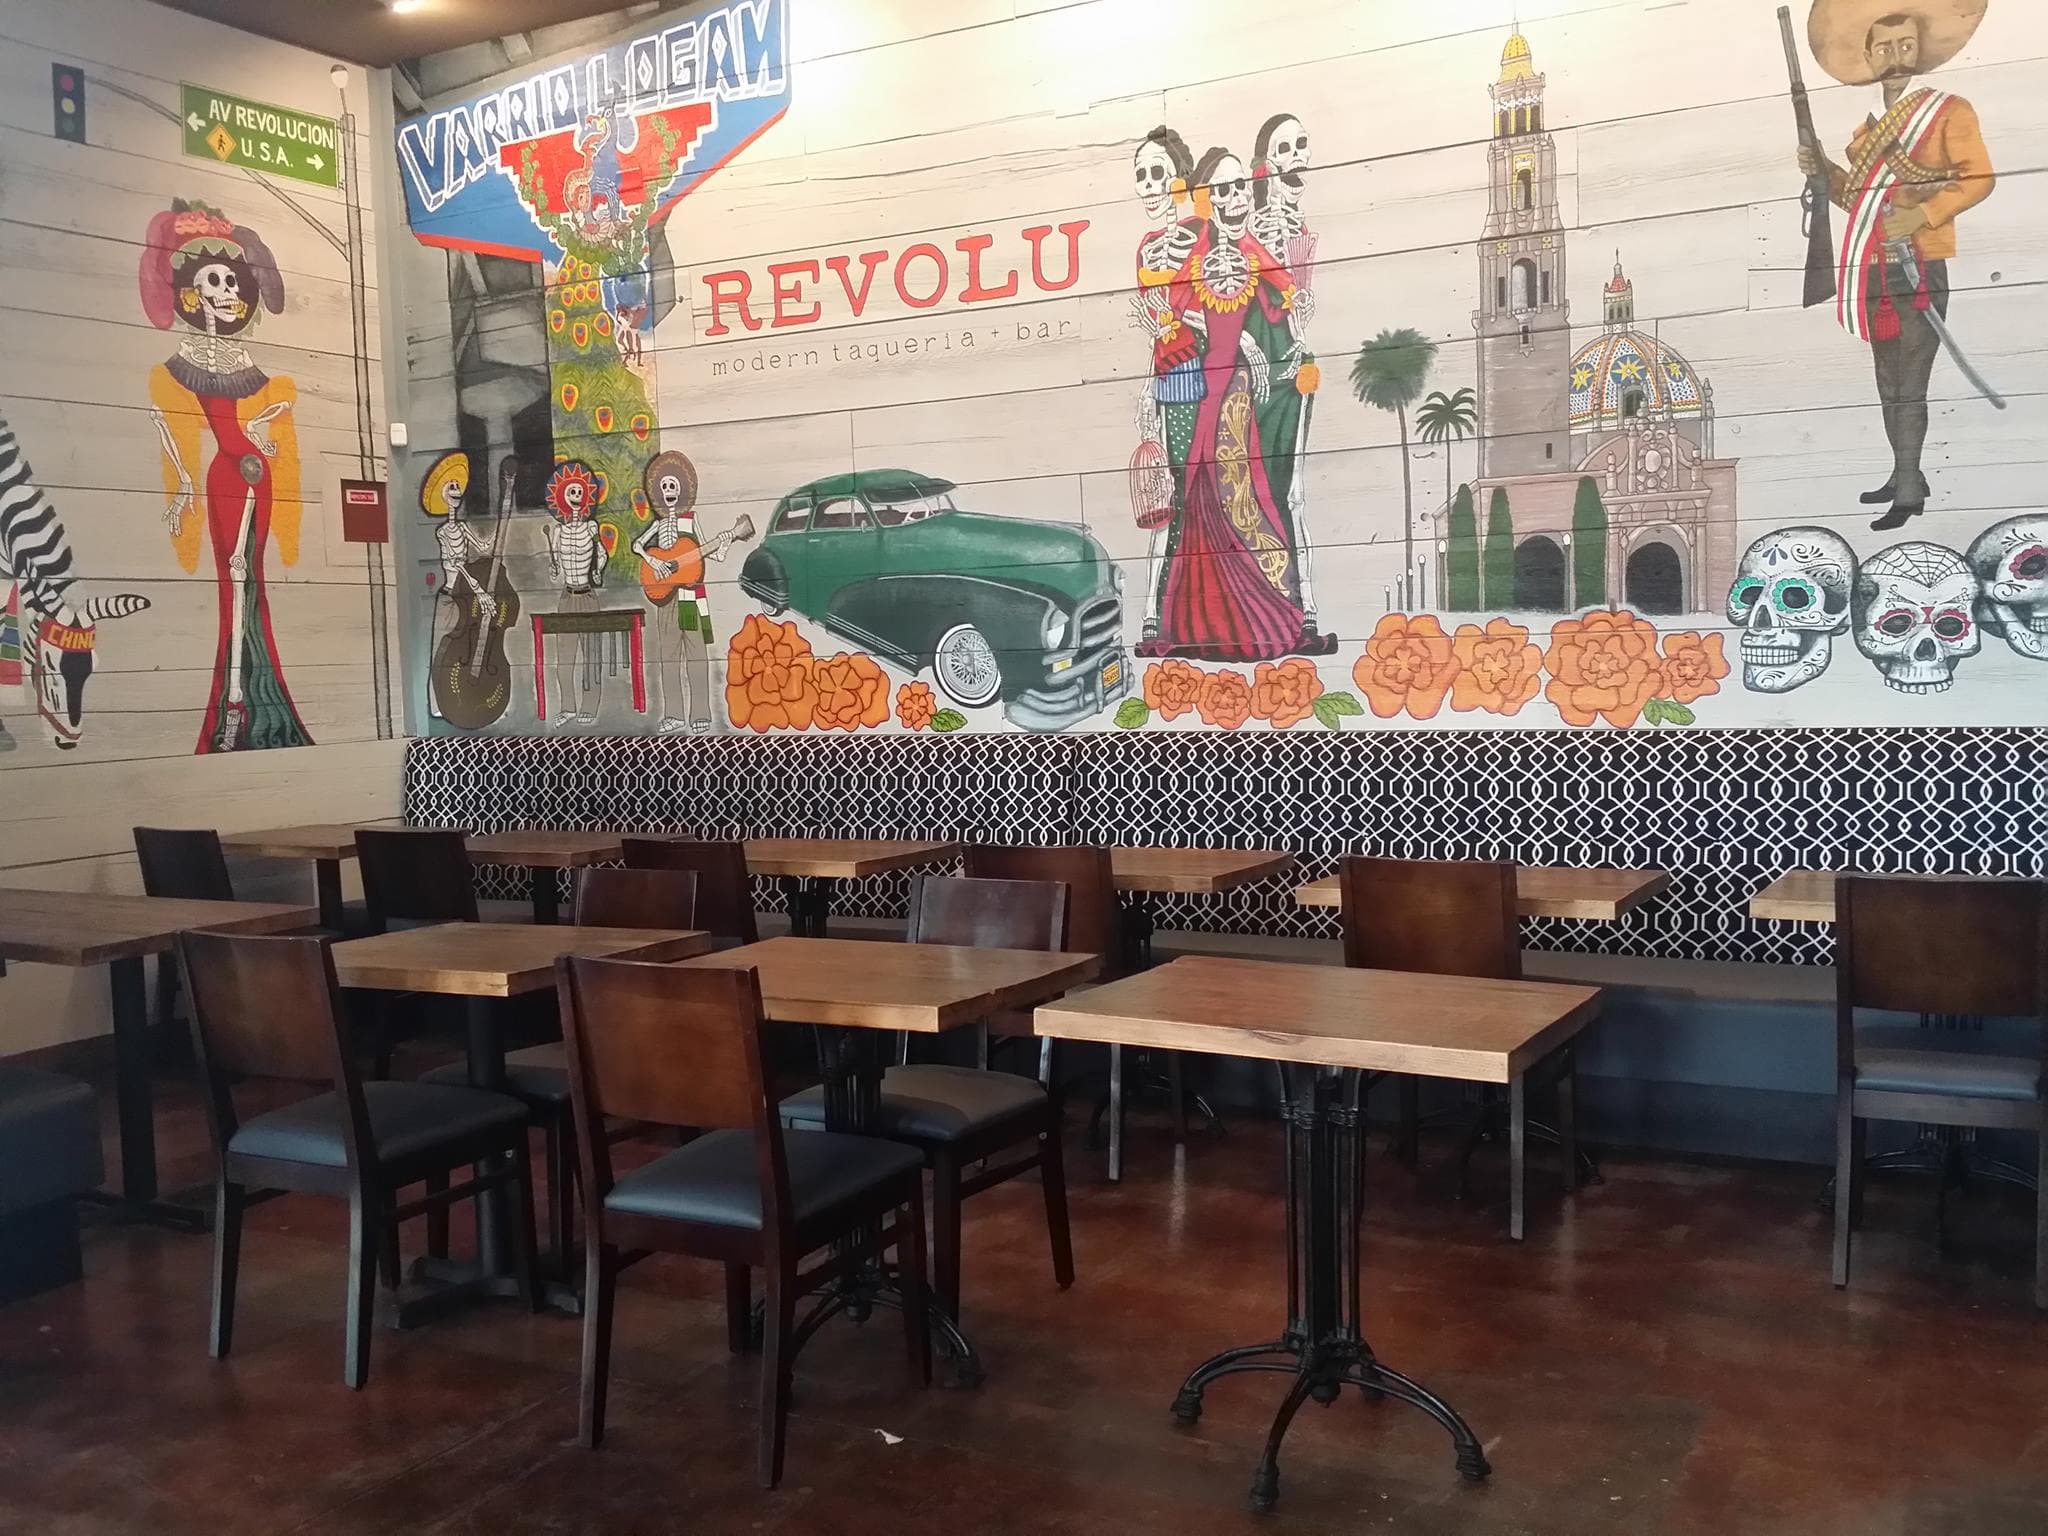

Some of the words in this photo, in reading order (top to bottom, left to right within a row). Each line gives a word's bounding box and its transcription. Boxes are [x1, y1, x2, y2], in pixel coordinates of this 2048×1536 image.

[209, 99, 231, 122] AV
[236, 105, 334, 149] REVOLUCION
[400, 64, 580, 212] VARRIO
[586, 0, 790, 117] LOGAN
[702, 220, 1090, 336] REVOLU
[712, 350, 818, 376] modern
[832, 328, 976, 364] taqueria
[1016, 318, 1071, 342] bar
